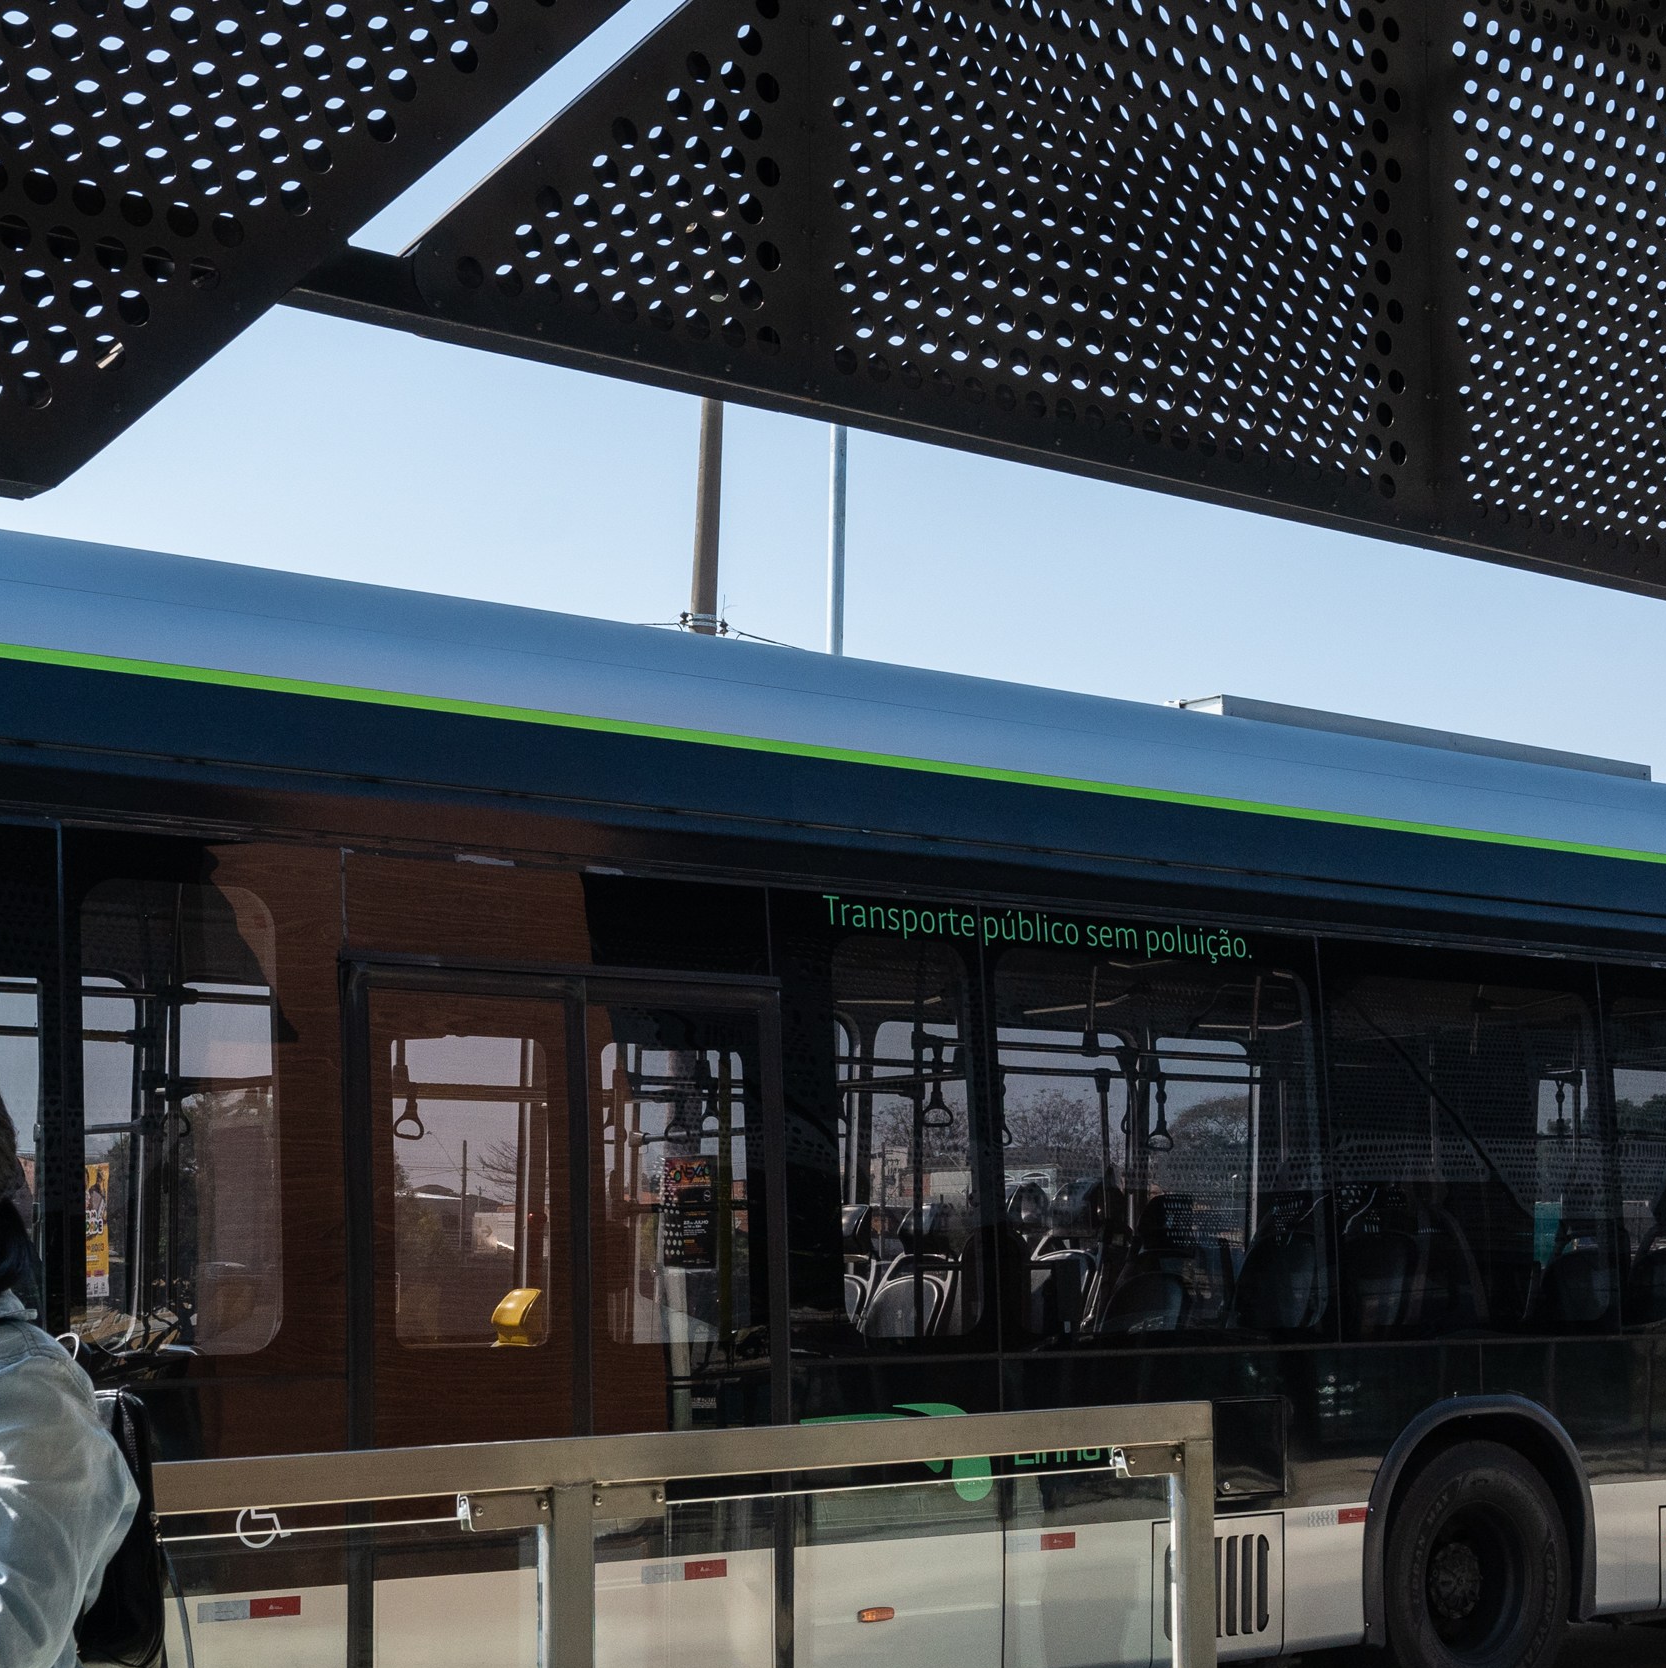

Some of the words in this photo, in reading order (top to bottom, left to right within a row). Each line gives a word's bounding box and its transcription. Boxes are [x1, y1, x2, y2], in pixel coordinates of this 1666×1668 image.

[822, 894, 975, 940] Transporte
[983, 909, 1079, 947] público
[1086, 923, 1138, 950] sem
[1145, 924, 1253, 964] poluição.
